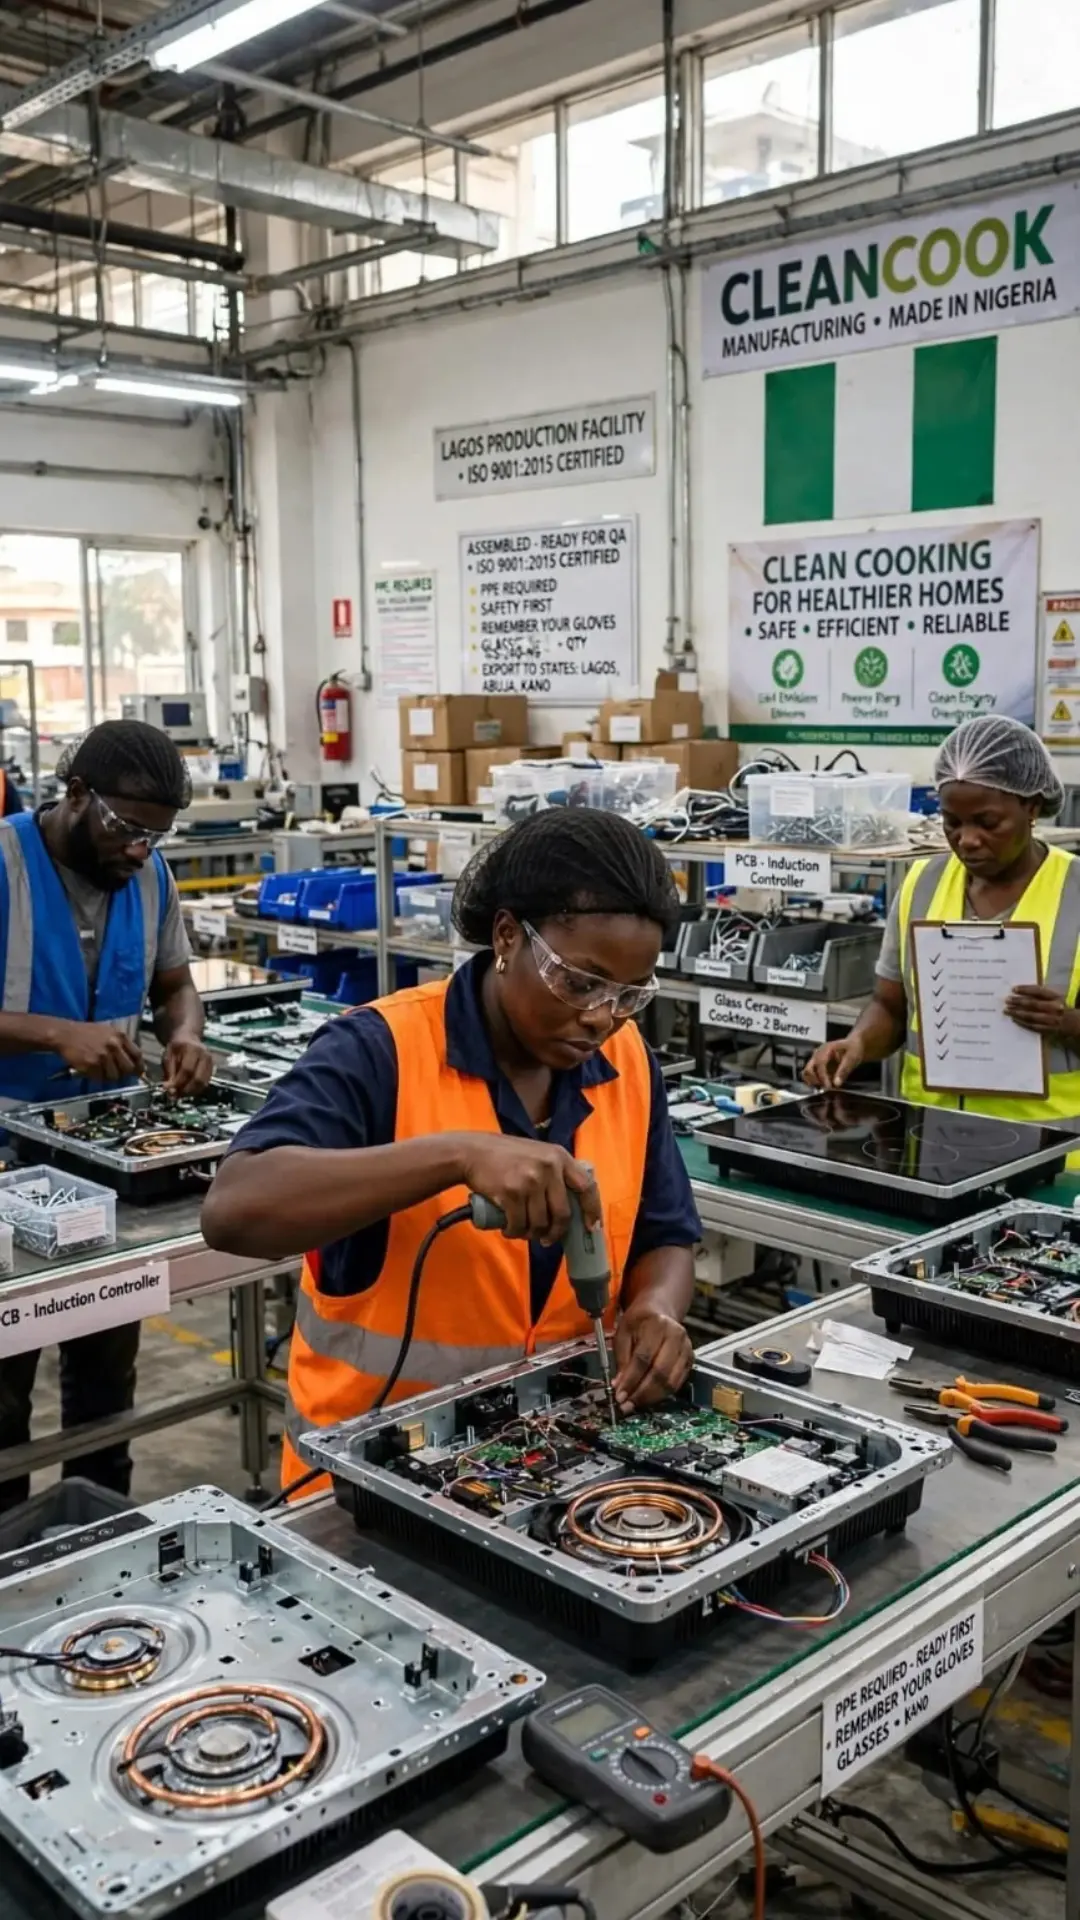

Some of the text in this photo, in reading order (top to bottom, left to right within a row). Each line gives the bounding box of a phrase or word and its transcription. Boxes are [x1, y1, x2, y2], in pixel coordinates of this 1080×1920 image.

[722, 204, 1054, 325] CLEANCOOK
[722, 277, 1057, 357] MANUFACTURING MADE IN NIGERIA
[441, 411, 645, 460] LAGOS PRODUCTION FACILITY
[468, 445, 624, 484] ISO 9001:2015 CERTIFIED
[467, 536, 531, 556] ASSEMBLED
[541, 532, 578, 549] READY
[583, 530, 606, 545] FOR
[609, 528, 627, 545] QA
[477, 548, 620, 574] ISO 9001:2015 CERTIFIED
[763, 540, 992, 584] CLEAN COOKING
[480, 582, 499, 596] PPE
[753, 577, 1003, 615] FOR HEALTHIER HOMES
[480, 598, 553, 616] SAFETY FIRST
[481, 615, 616, 634] REMEMBER YOUR GLOVES
[758, 610, 1010, 640] SAFE EFFICIENT RELIABLE
[566, 636, 588, 651] QTY
[482, 660, 620, 677] EXPORT TO STATES: LAGOS,
[521, 678, 551, 692] KANO
[735, 854, 757, 868] PCB
[768, 856, 820, 872] Induction
[750, 872, 804, 887] Controller
[714, 993, 788, 1016] Glass Ceramic
[708, 1009, 753, 1028] Cooktop
[763, 1018, 770, 1030] 2
[773, 1019, 810, 1036] Burner
[0, 1308, 20, 1326] CB
[34, 1292, 95, 1318] Induction
[99, 1275, 161, 1300] Controller
[835, 1692, 857, 1722] PPE
[916, 1632, 948, 1668] READY
[950, 1614, 975, 1644] FIRST
[835, 1639, 975, 1748] REMEMBER YOUR GLOVES
[837, 1719, 890, 1771] GLASSES
